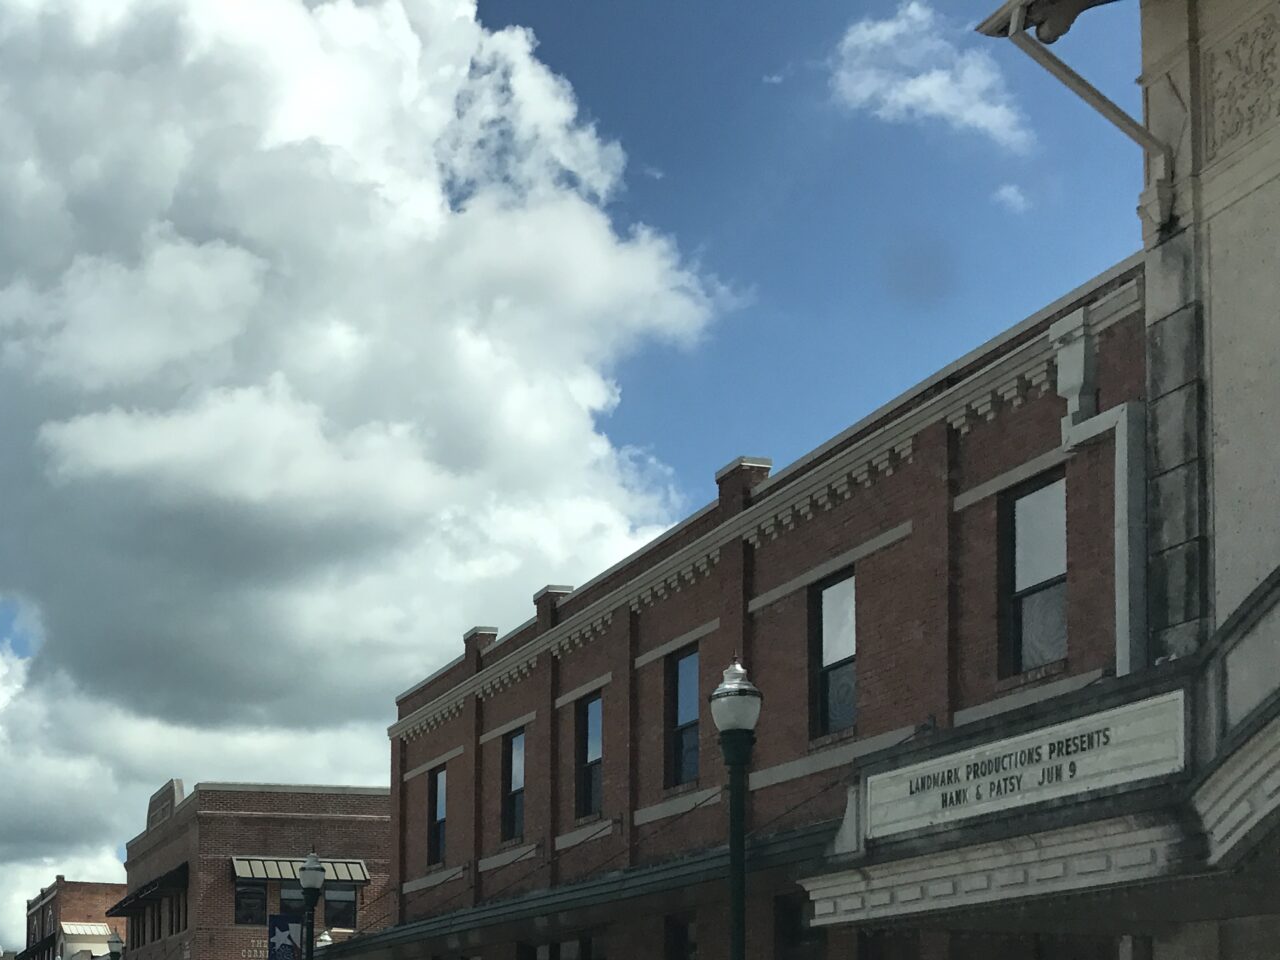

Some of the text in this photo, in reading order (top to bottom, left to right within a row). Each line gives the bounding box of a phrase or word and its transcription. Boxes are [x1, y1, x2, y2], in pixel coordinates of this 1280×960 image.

[909, 728, 1111, 796] LANDMARK PRODUCTIONS PRESENTS
[941, 760, 1077, 809] HANK & PATSY JUN 9
